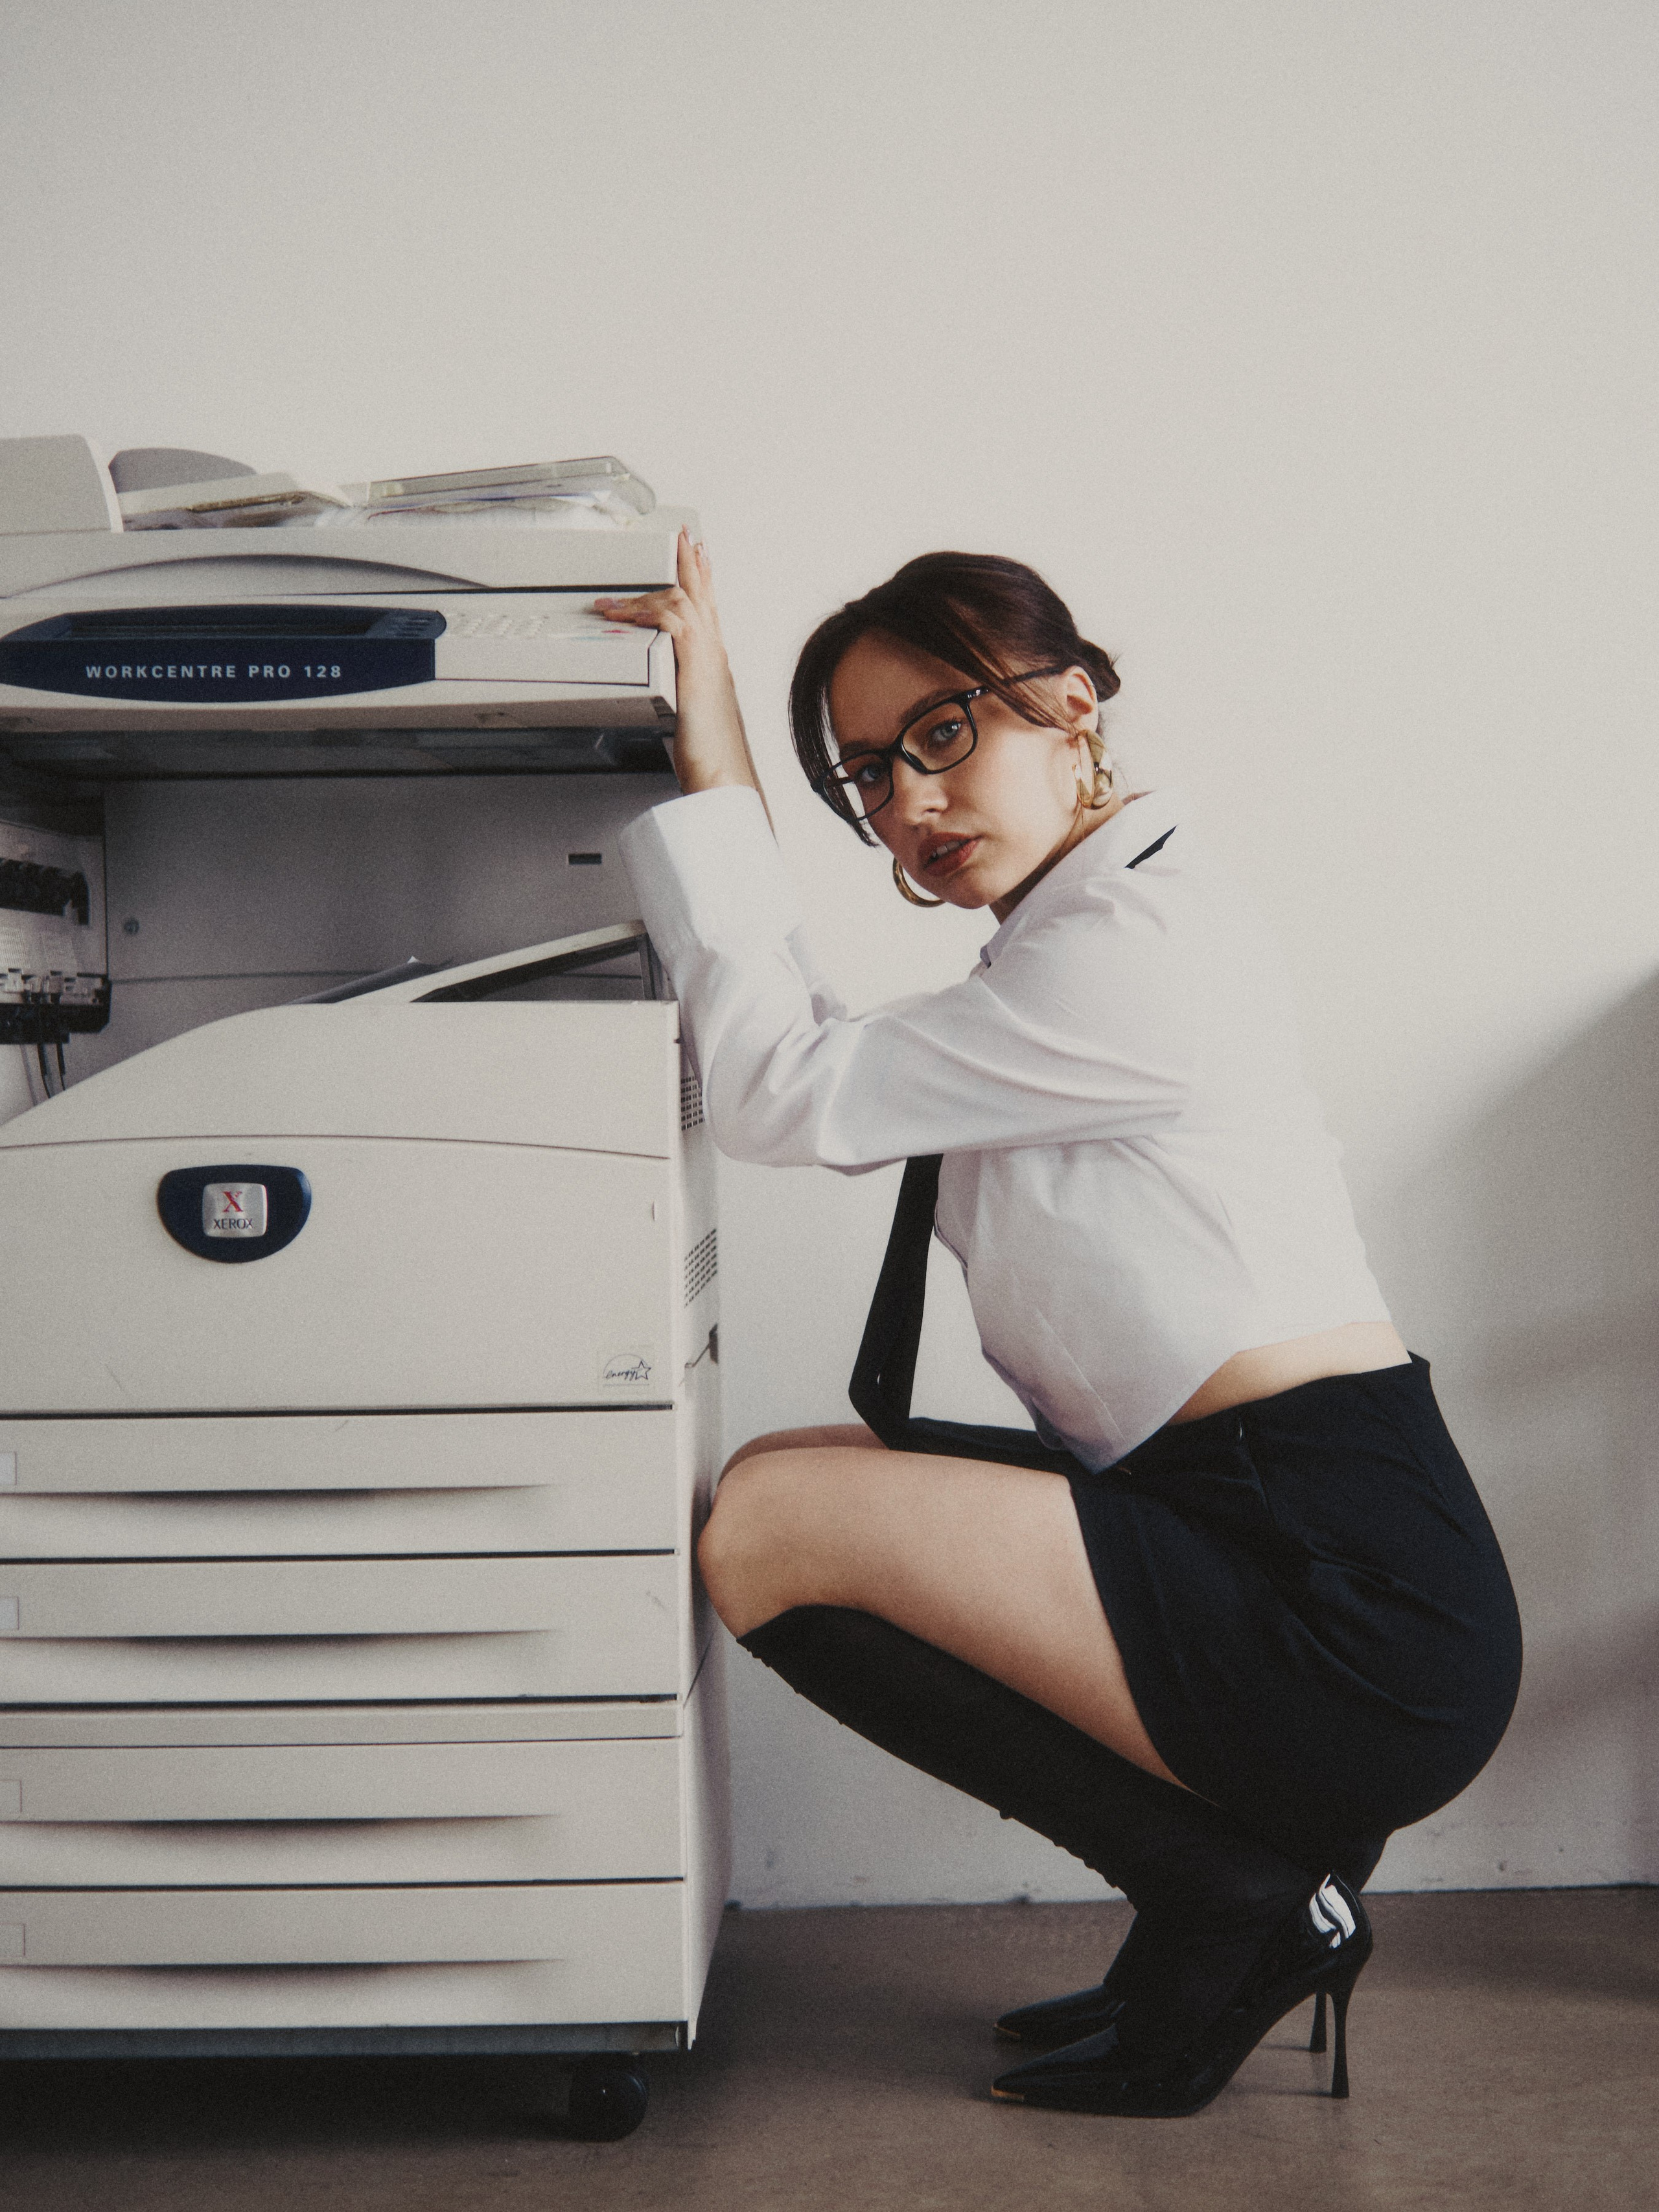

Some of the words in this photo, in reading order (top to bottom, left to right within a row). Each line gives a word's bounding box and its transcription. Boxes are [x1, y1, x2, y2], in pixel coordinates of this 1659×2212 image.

[86, 665, 235, 678] WORKCENTRE
[248, 664, 290, 678] PRO
[304, 665, 341, 678] 128
[222, 1191, 243, 1212] X
[213, 1218, 253, 1229] XEROX
